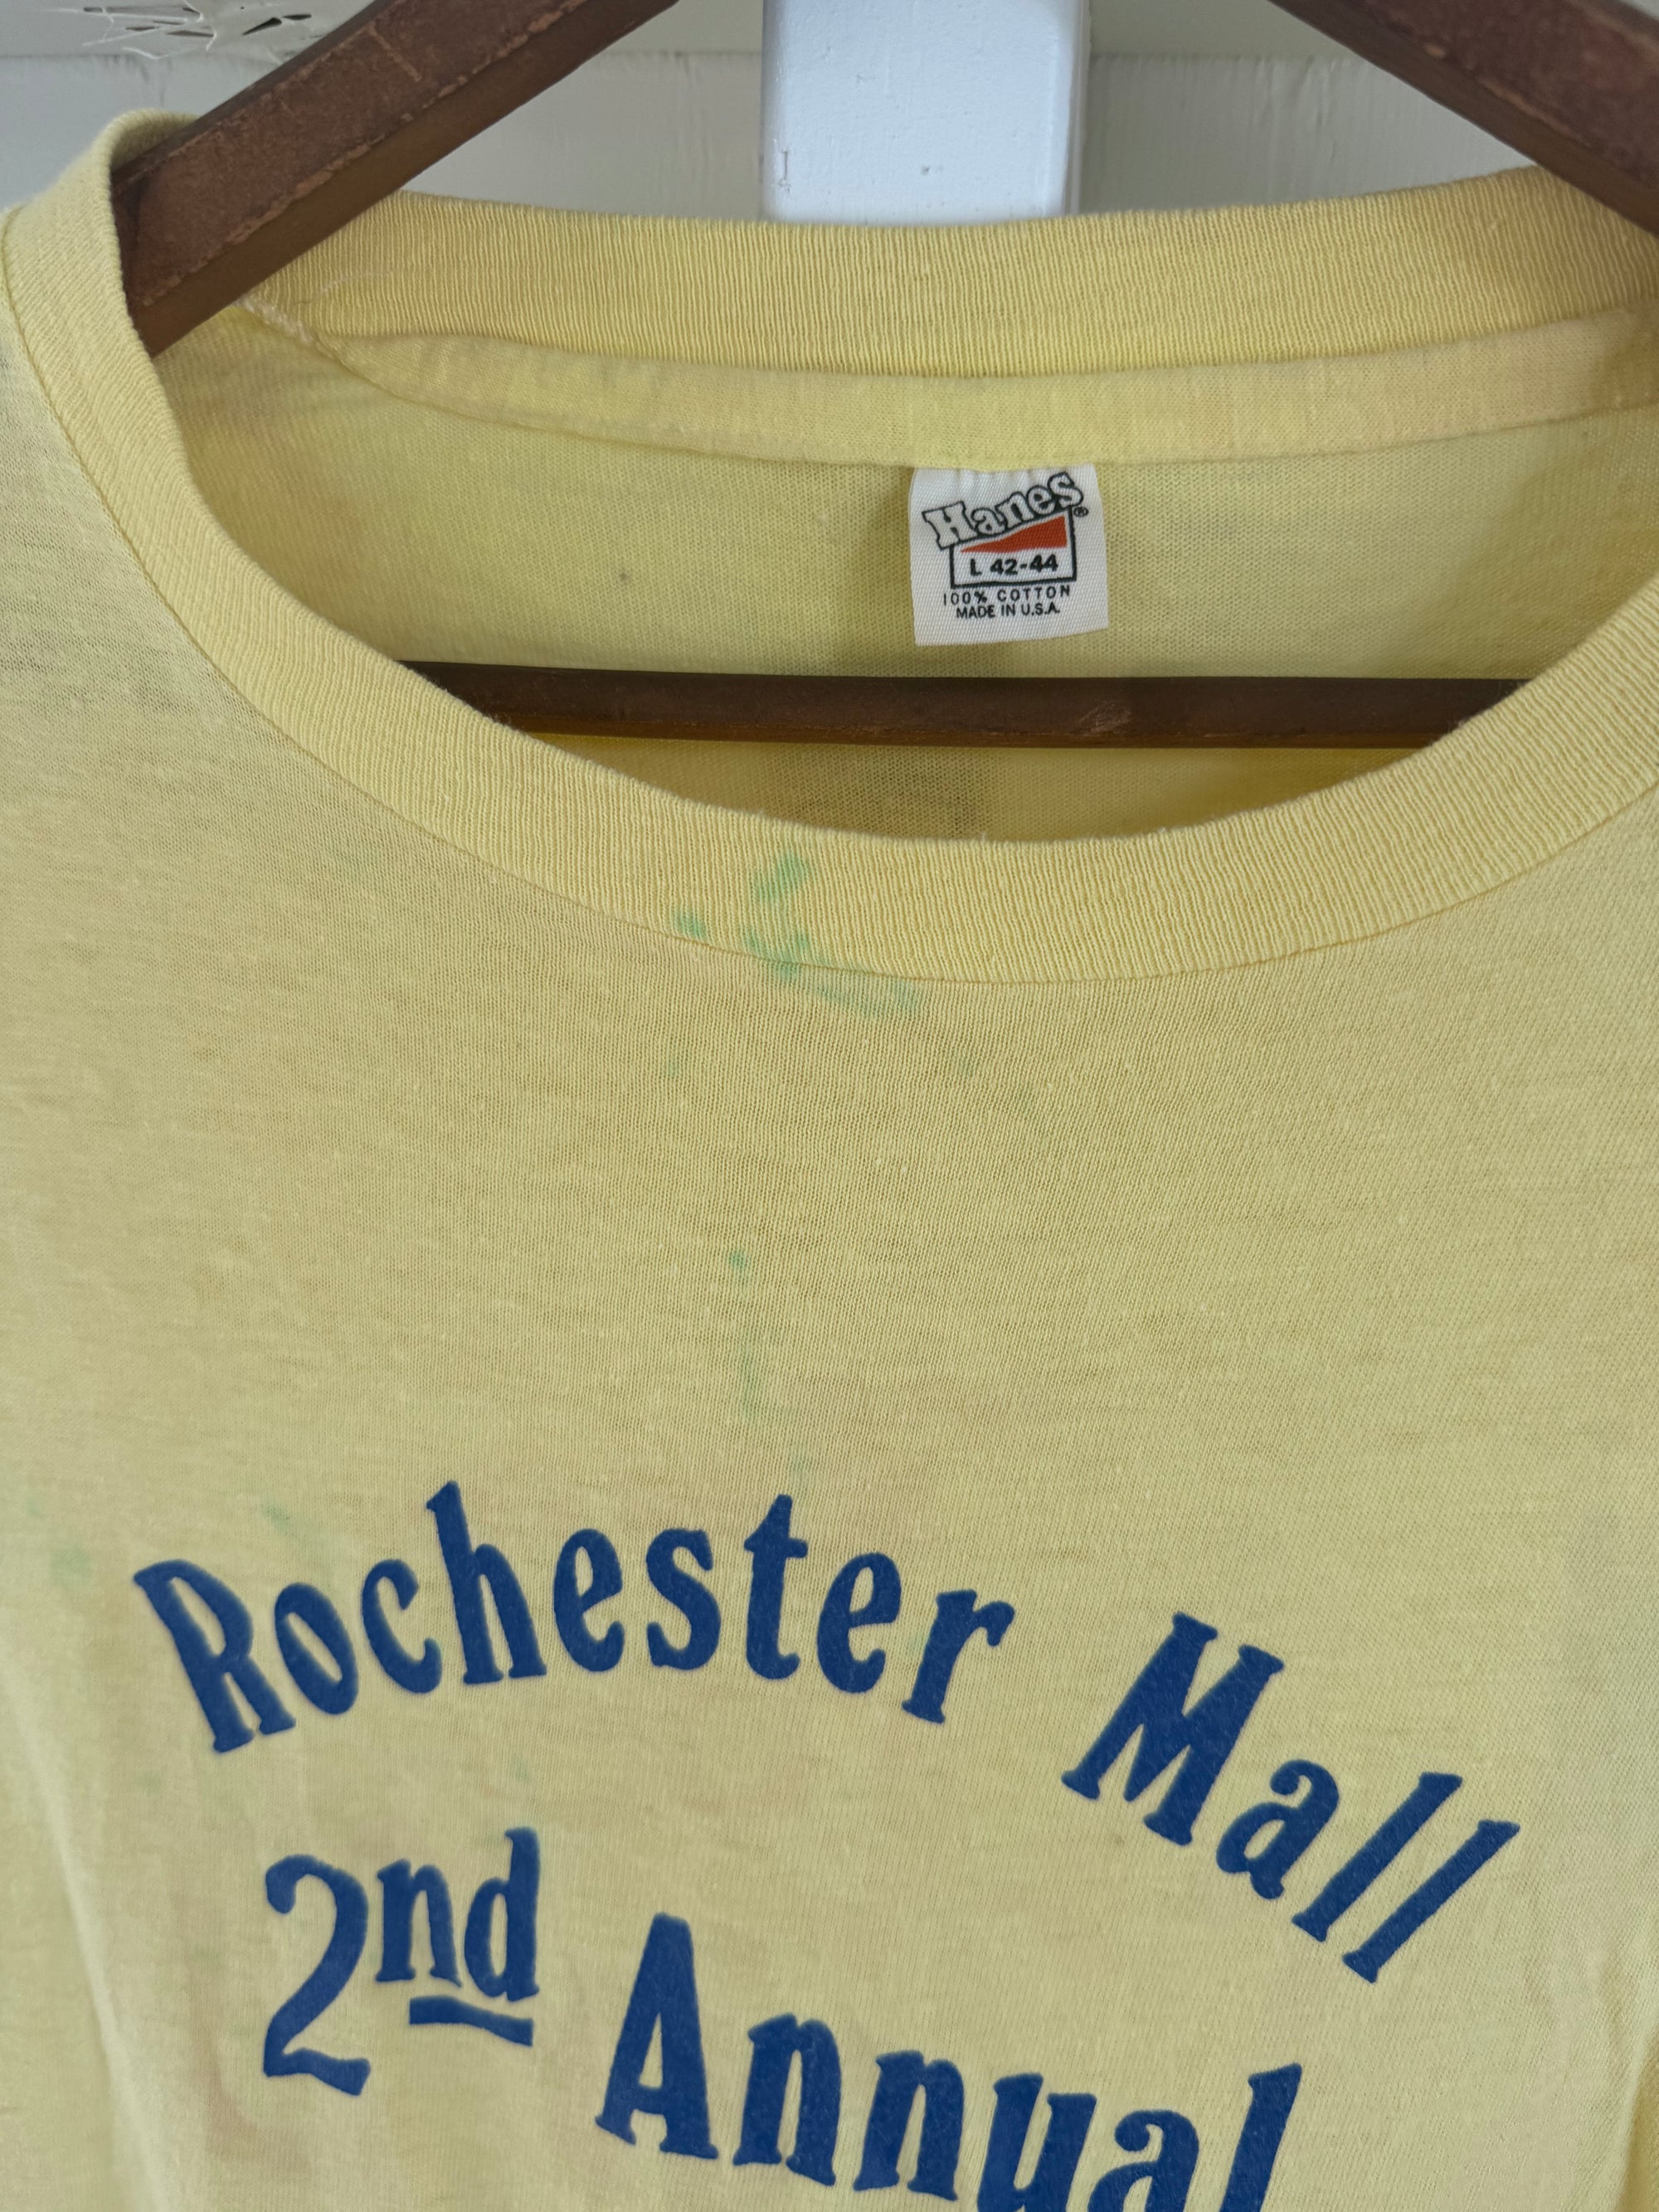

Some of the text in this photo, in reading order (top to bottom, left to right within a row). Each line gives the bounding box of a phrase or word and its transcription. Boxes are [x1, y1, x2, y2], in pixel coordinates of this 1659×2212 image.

[922, 471, 1084, 551] Hanes
[970, 554, 1058, 576] L 42-44
[942, 585, 1070, 605] 100% COTTON
[956, 605, 995, 620] MADE
[1001, 604, 1016, 616] IN
[133, 1482, 1520, 1983] Rochester Mall
[263, 1827, 1301, 2212] 2nd Annual
